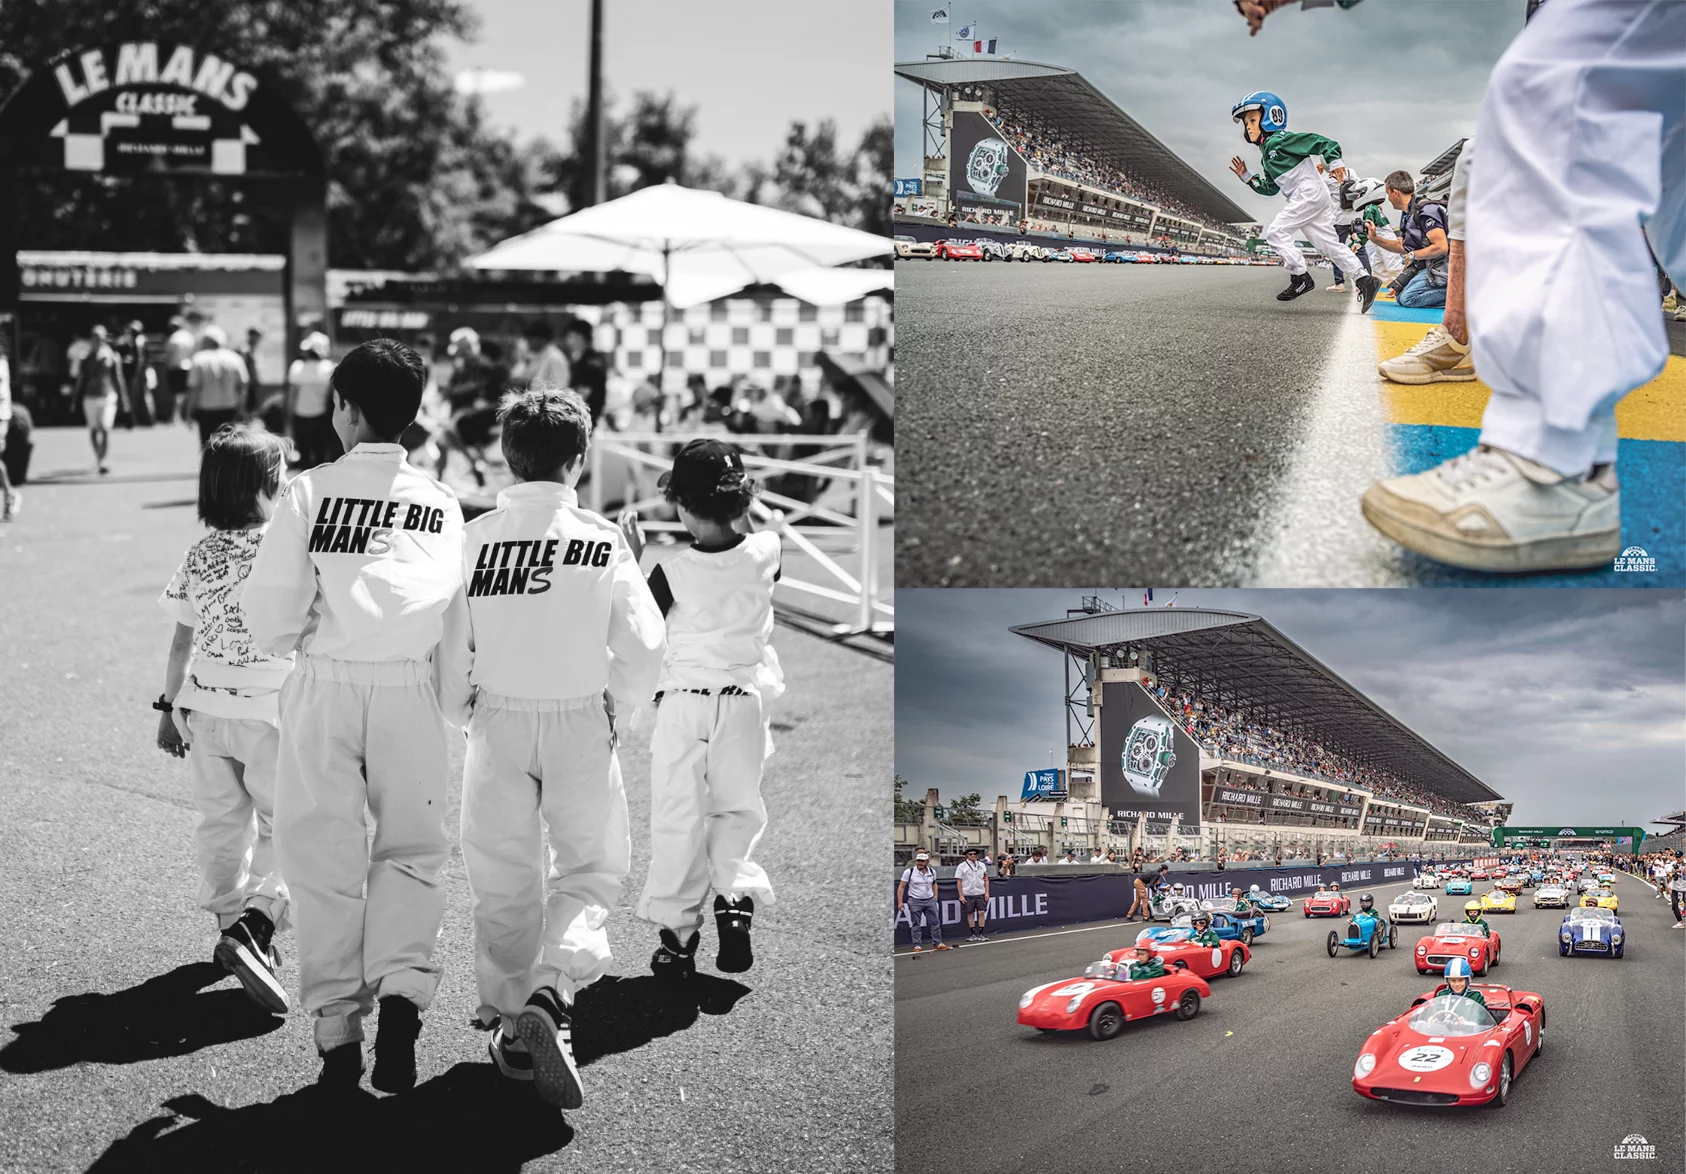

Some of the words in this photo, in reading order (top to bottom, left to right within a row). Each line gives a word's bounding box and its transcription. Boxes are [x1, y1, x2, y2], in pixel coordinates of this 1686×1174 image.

[54, 47, 109, 107] LE
[115, 42, 258, 111] MANS
[116, 92, 198, 117] CLASSIC
[1271, 108, 1284, 123] 89
[315, 496, 399, 528] LITTLE
[402, 503, 445, 534] BIG
[308, 524, 395, 555] MANS
[475, 538, 560, 570] LITTLE
[562, 538, 613, 568] BIG
[467, 566, 554, 598] MANS
[1221, 790, 1247, 803] RICHARD
[1246, 794, 1262, 805] MILLE
[1272, 797, 1292, 808] RICHARD
[1270, 875, 1302, 892] RICHARD
[1303, 873, 1322, 888] MILLE
[1341, 871, 1360, 883] RICHARD
[1360, 869, 1372, 880] MILLE
[1198, 881, 1232, 899] MILLE
[1410, 1052, 1442, 1063] 22
